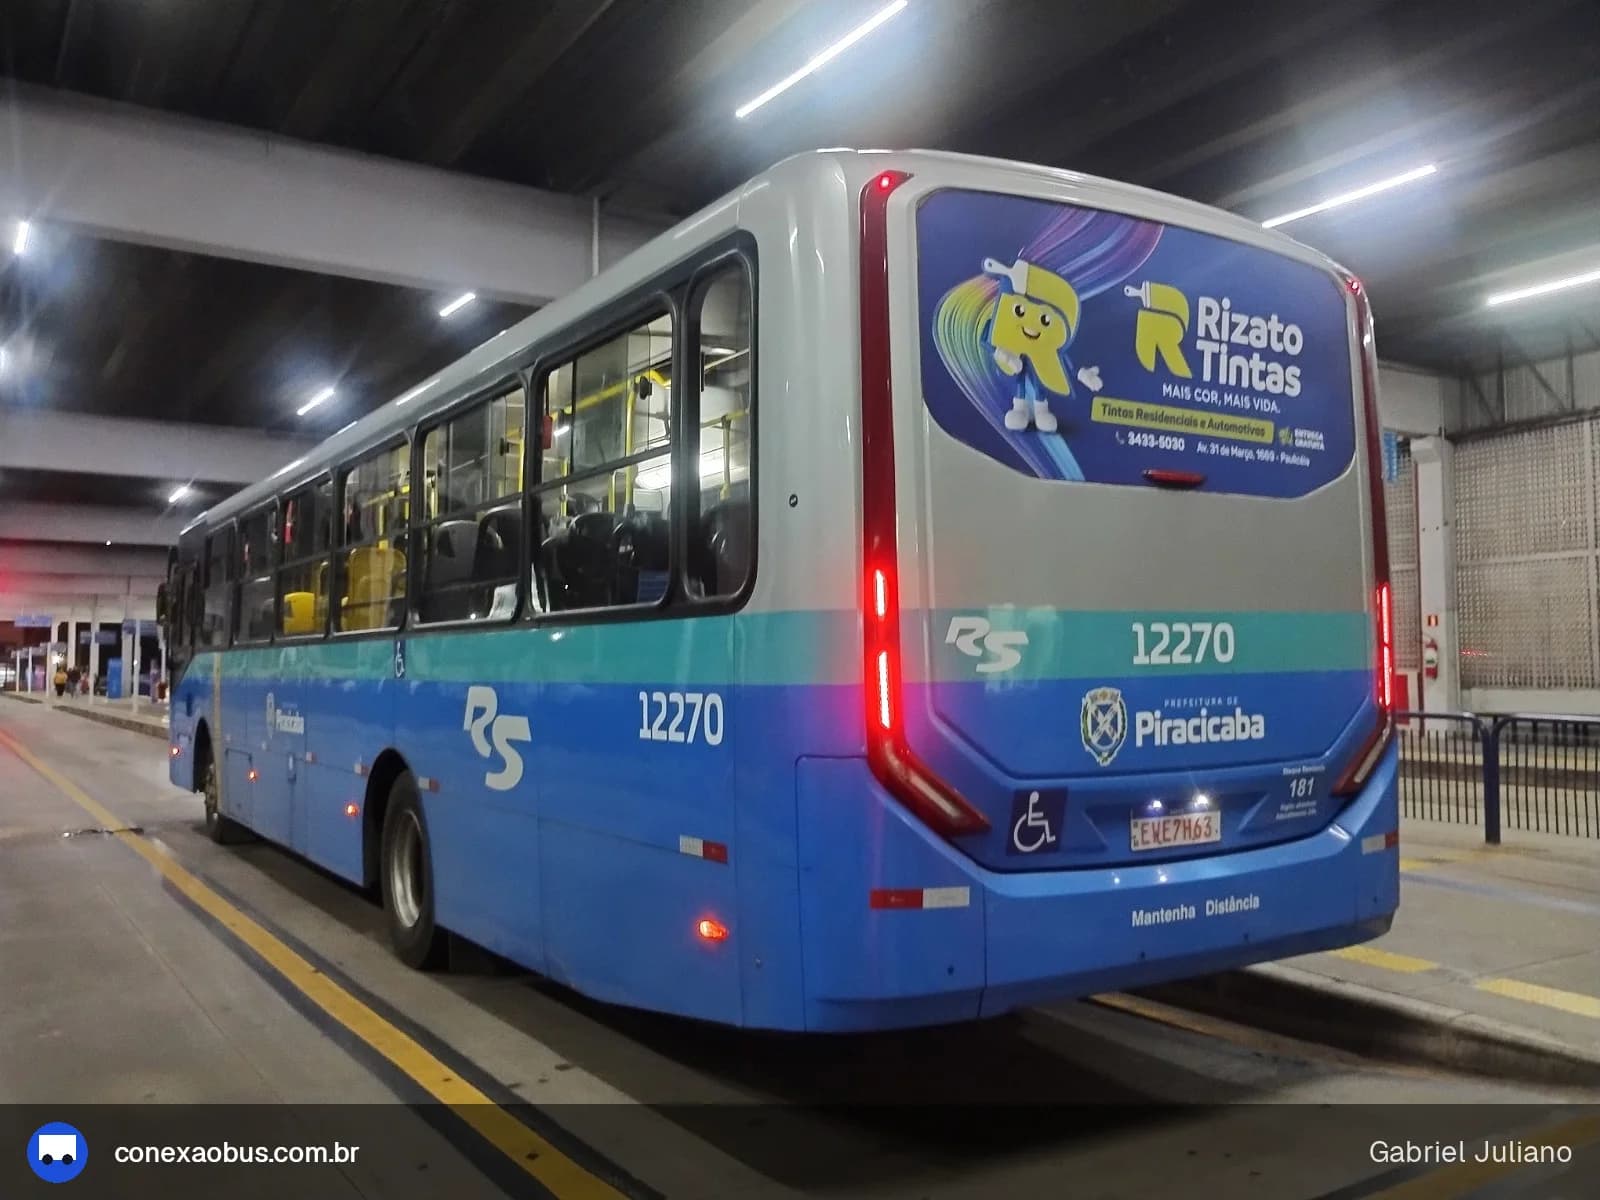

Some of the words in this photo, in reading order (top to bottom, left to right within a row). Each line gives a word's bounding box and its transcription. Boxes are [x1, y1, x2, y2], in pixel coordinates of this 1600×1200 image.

[1197, 296, 1304, 355] Rizato
[1196, 340, 1301, 397] Tintas
[1162, 383, 1192, 400] MAIS
[1194, 387, 1221, 407] COR,
[1223, 392, 1251, 409] MAIS
[1253, 396, 1281, 414] VIDA.
[1101, 403, 1134, 420] Tintas
[1136, 407, 1199, 428] Residenciais
[1207, 417, 1266, 438] Automotivos
[944, 616, 1029, 673] RS
[1132, 622, 1235, 665] 12270
[639, 691, 724, 746] 12270
[1164, 696, 1223, 709] PREFEITURA
[463, 685, 532, 791] RS
[1135, 707, 1265, 748] Piracicaba
[1289, 776, 1315, 799] 181
[1131, 903, 1196, 928] Mantenha
[1205, 892, 1261, 917] Distância
